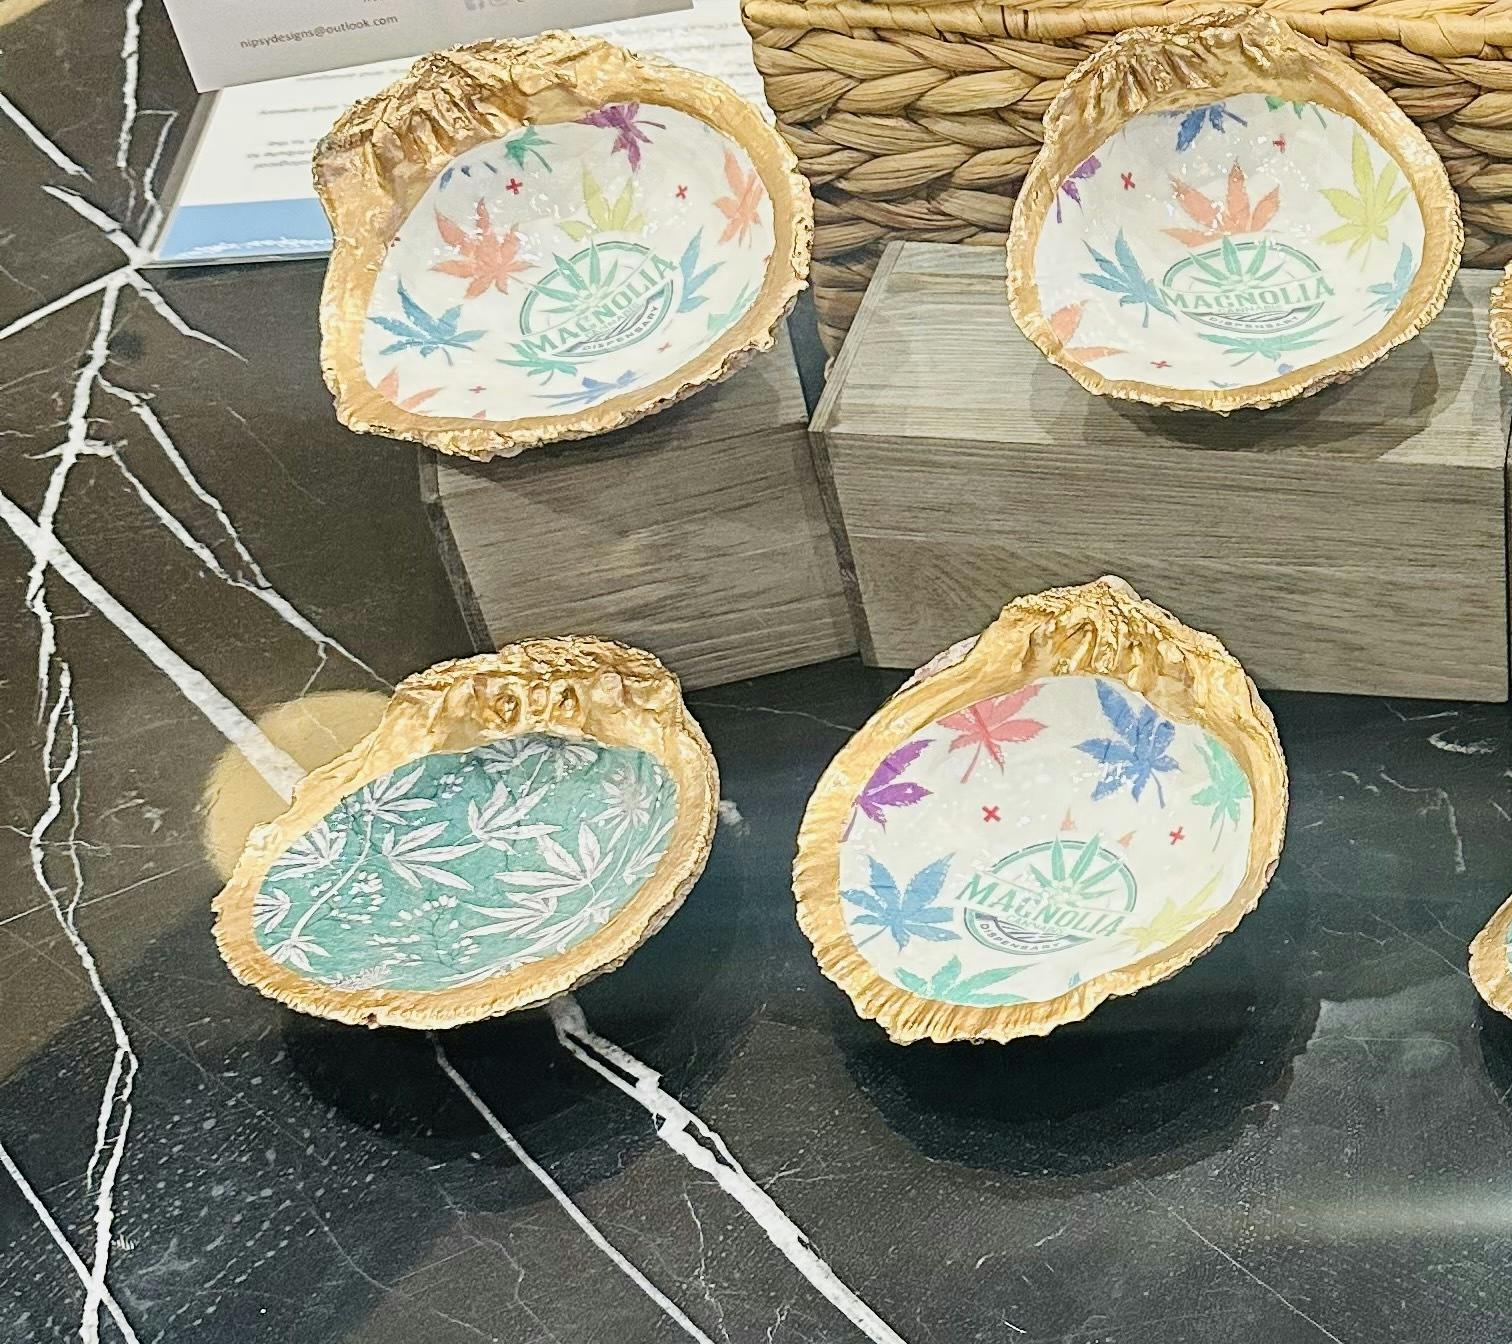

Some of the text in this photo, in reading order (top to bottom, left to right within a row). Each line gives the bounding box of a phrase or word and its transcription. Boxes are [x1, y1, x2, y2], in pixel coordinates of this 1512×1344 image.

[240, 14, 398, 49] nipsydesigns@outlook.com
[521, 252, 678, 355] MAGNOLIA
[1160, 275, 1336, 311] MAGNOLIA
[582, 304, 660, 352] DISPENSARY
[955, 872, 1126, 937] MAGNOLIA
